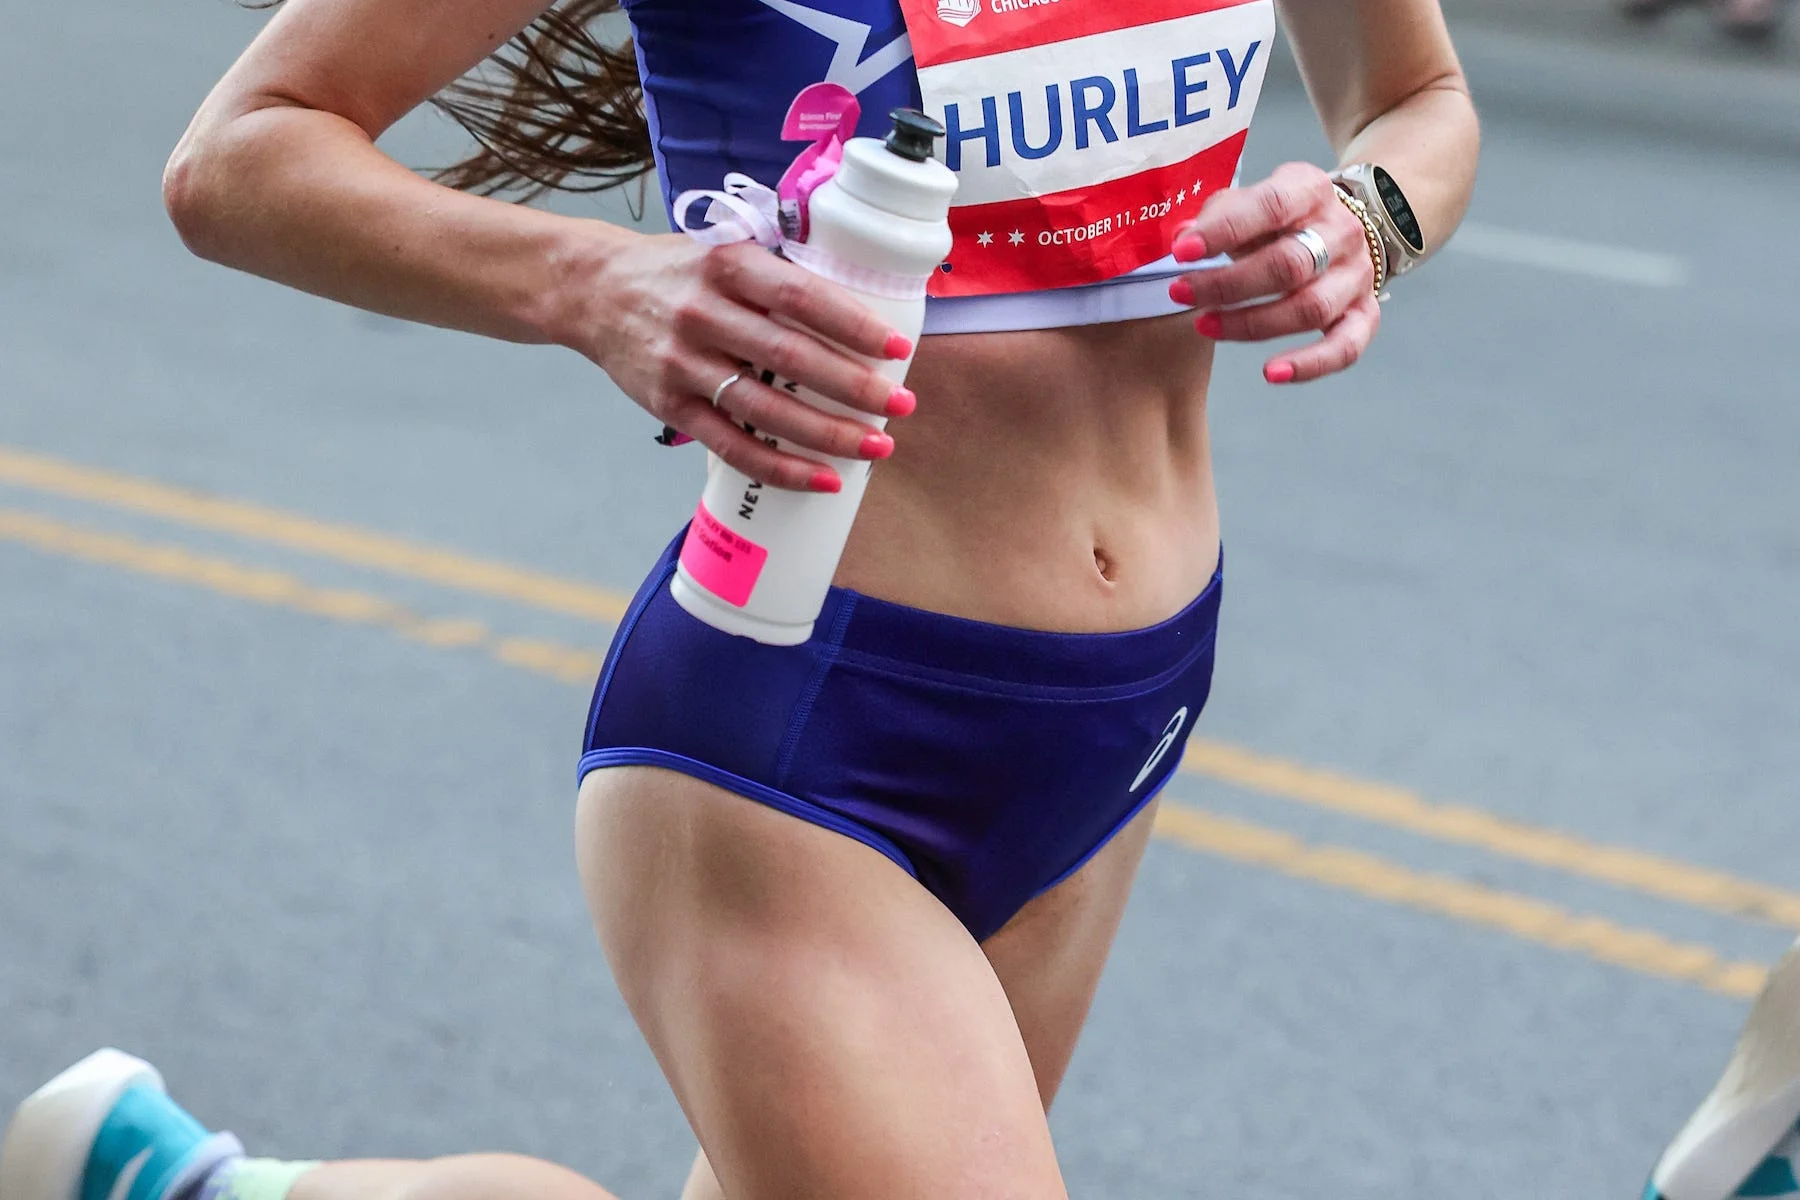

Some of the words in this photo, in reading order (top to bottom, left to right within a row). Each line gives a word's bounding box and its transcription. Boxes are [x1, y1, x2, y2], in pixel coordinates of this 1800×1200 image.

[943, 40, 1262, 172] HURLEY
[1037, 217, 1113, 246] OCTOBER
[1116, 209, 1136, 229] 11,
